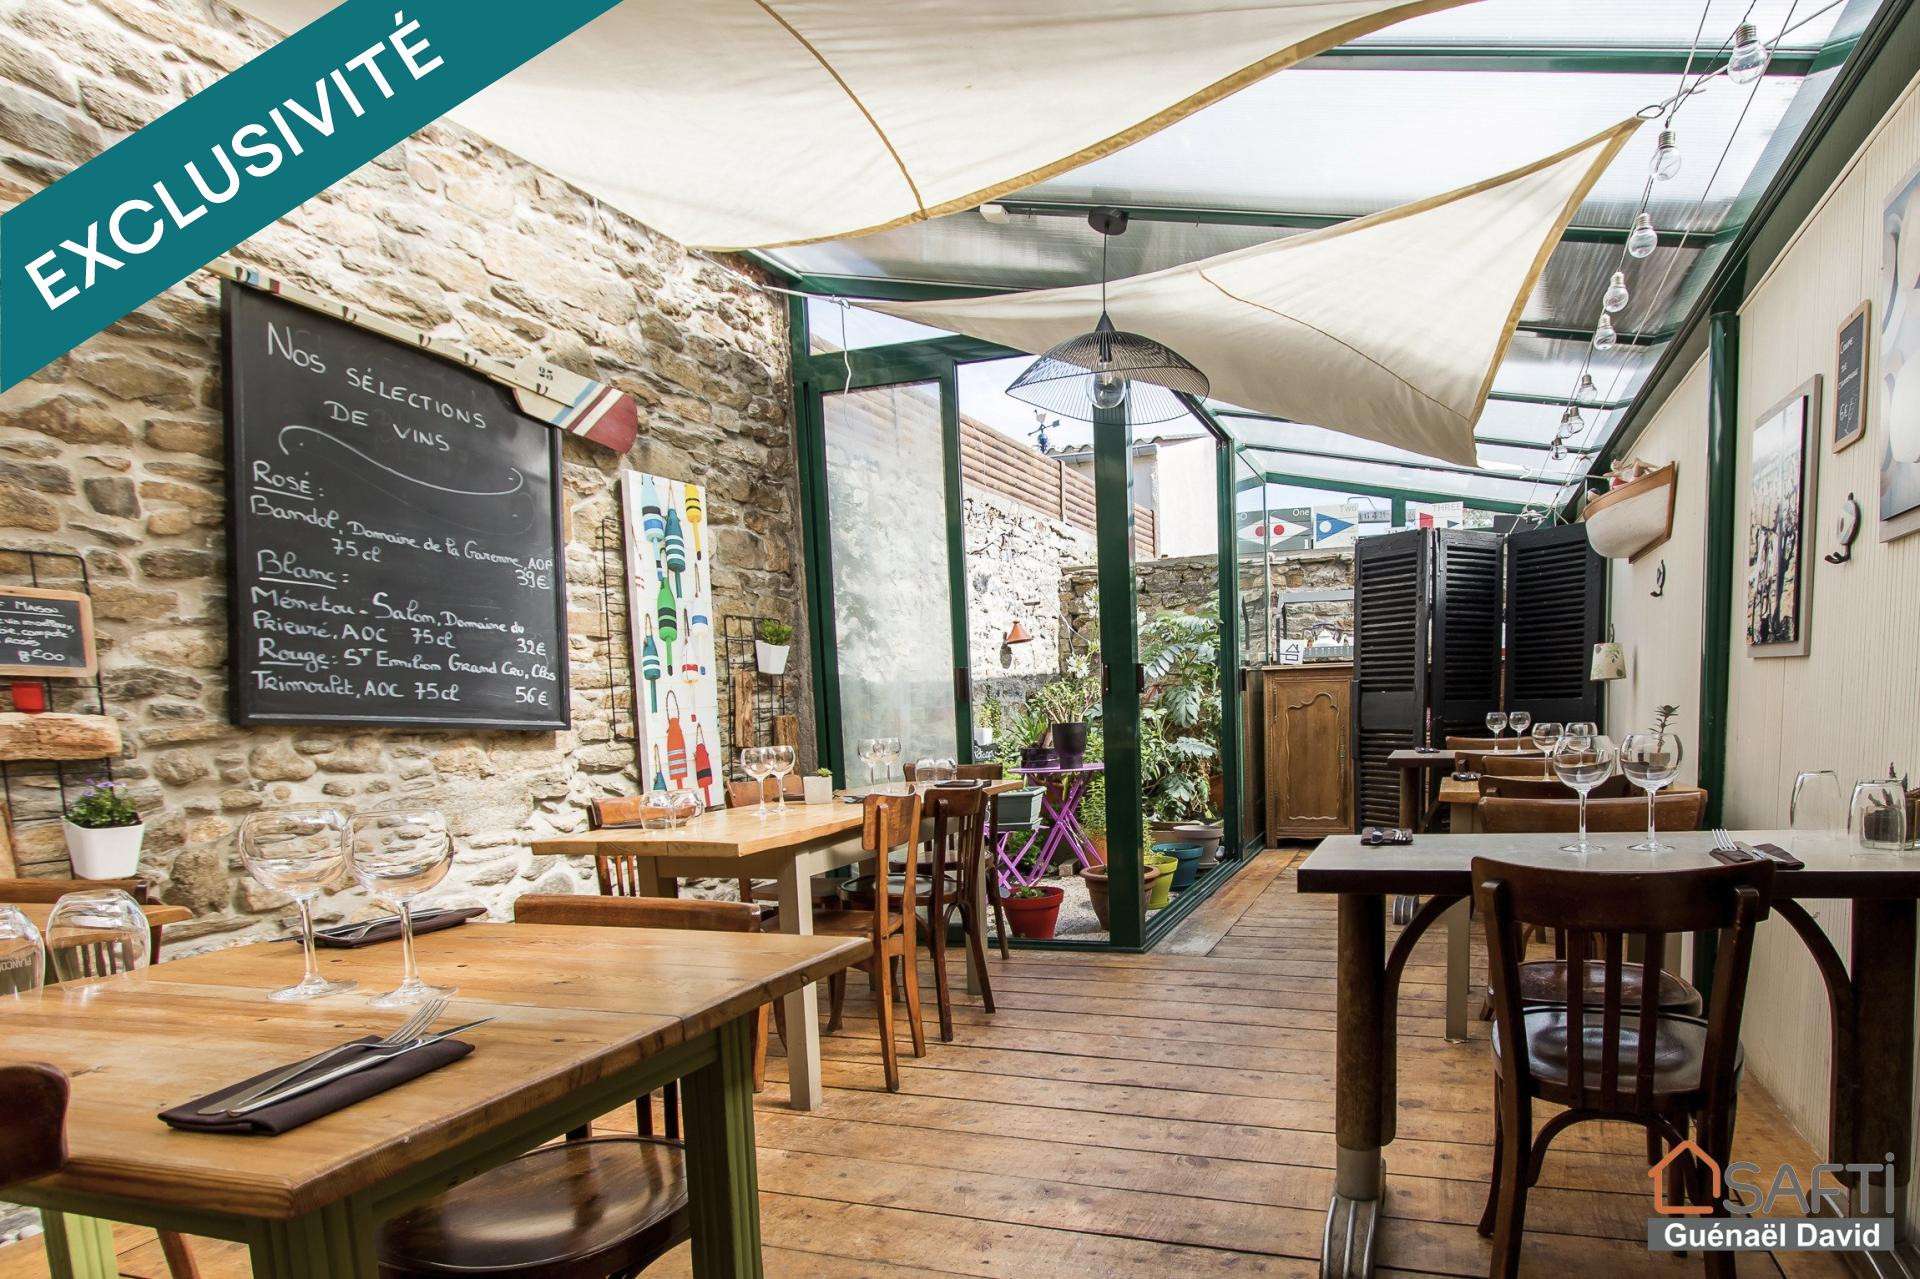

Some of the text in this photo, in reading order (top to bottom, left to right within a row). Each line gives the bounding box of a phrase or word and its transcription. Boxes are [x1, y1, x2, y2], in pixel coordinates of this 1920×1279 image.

[267, 322, 487, 429] NOS SÉLECTIONS
[323, 400, 450, 451] DE VINS
[1292, 507, 1310, 517] One
[1432, 503, 1462, 512] THREE
[346, 521, 420, 550] Domaine
[423, 537, 442, 552] de
[445, 537, 460, 557] la
[341, 623, 388, 643] AOC
[440, 610, 508, 633] Domaine
[510, 621, 525, 634] du
[364, 679, 405, 698] AOC
[514, 686, 550, 706] 56€
